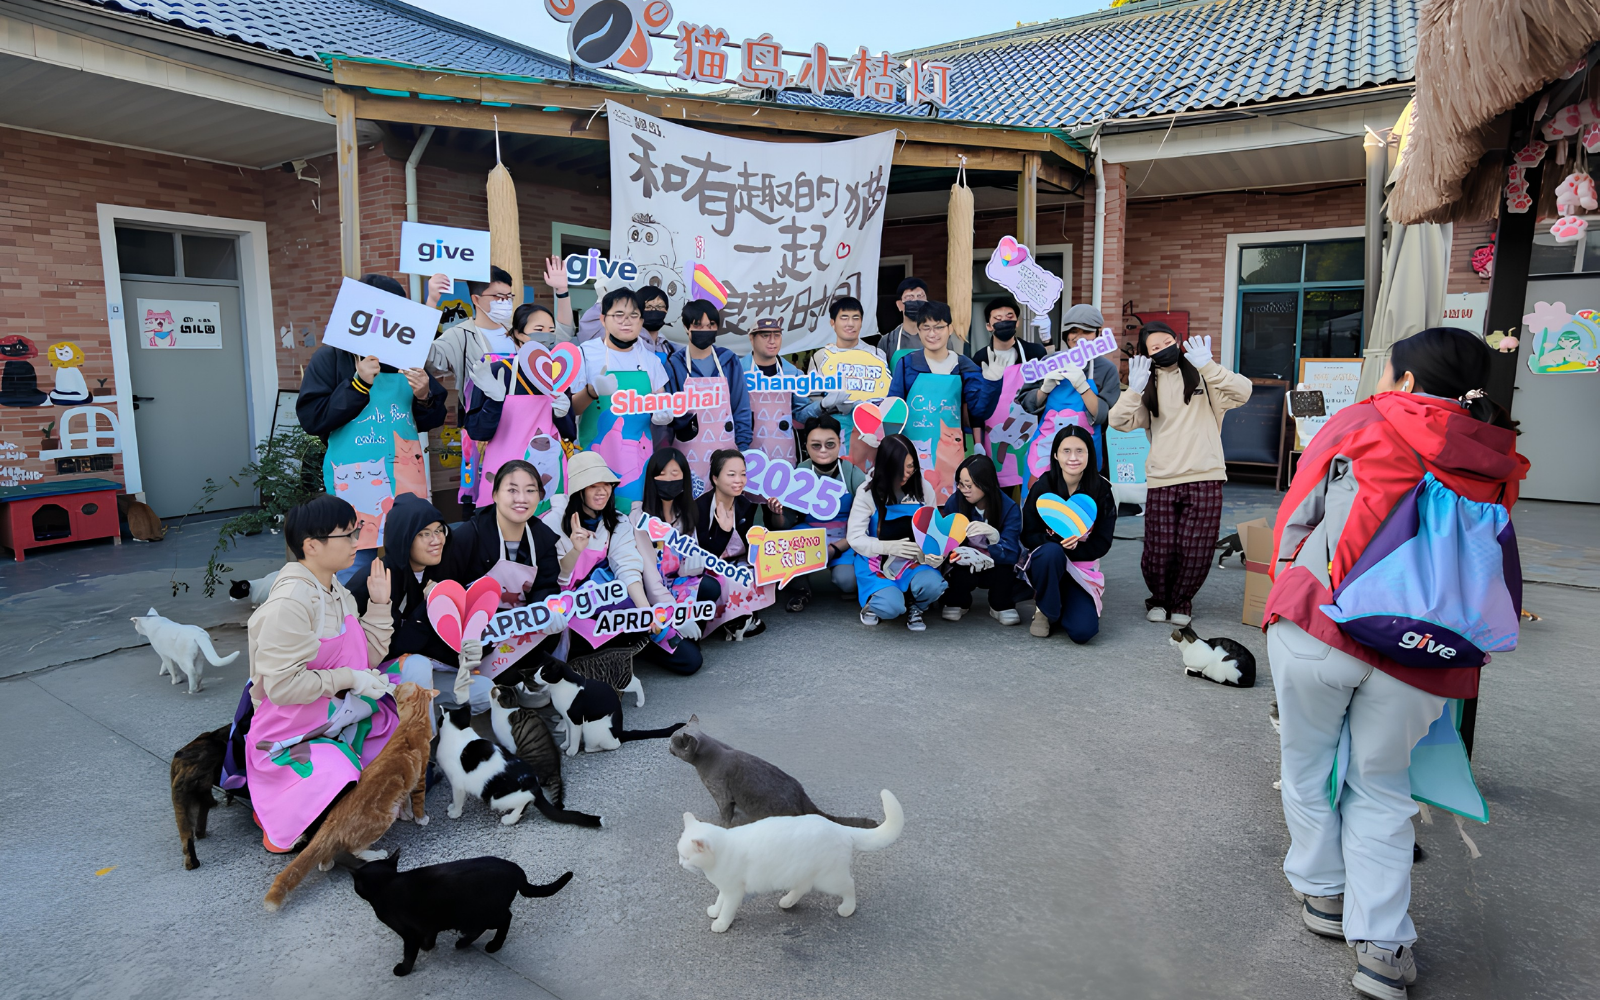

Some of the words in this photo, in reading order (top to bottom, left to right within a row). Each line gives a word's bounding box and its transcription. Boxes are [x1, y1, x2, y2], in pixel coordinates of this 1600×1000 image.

[675, 22, 953, 107] 猫岛小桔灯
[628, 132, 887, 238] 和有趣的猫
[418, 239, 475, 262] give
[566, 248, 638, 283] give
[733, 215, 830, 282] 一起
[348, 308, 416, 345] give
[1022, 330, 1115, 382] Shanghai
[612, 386, 720, 415] Shanghai
[744, 371, 843, 396] Shanghai
[744, 452, 843, 517] 2025
[667, 530, 752, 588] Microsoft
[481, 605, 550, 642] APRD
[575, 583, 624, 615] give
[595, 610, 653, 635] APRD
[674, 600, 713, 625] give
[1398, 631, 1457, 660] give
